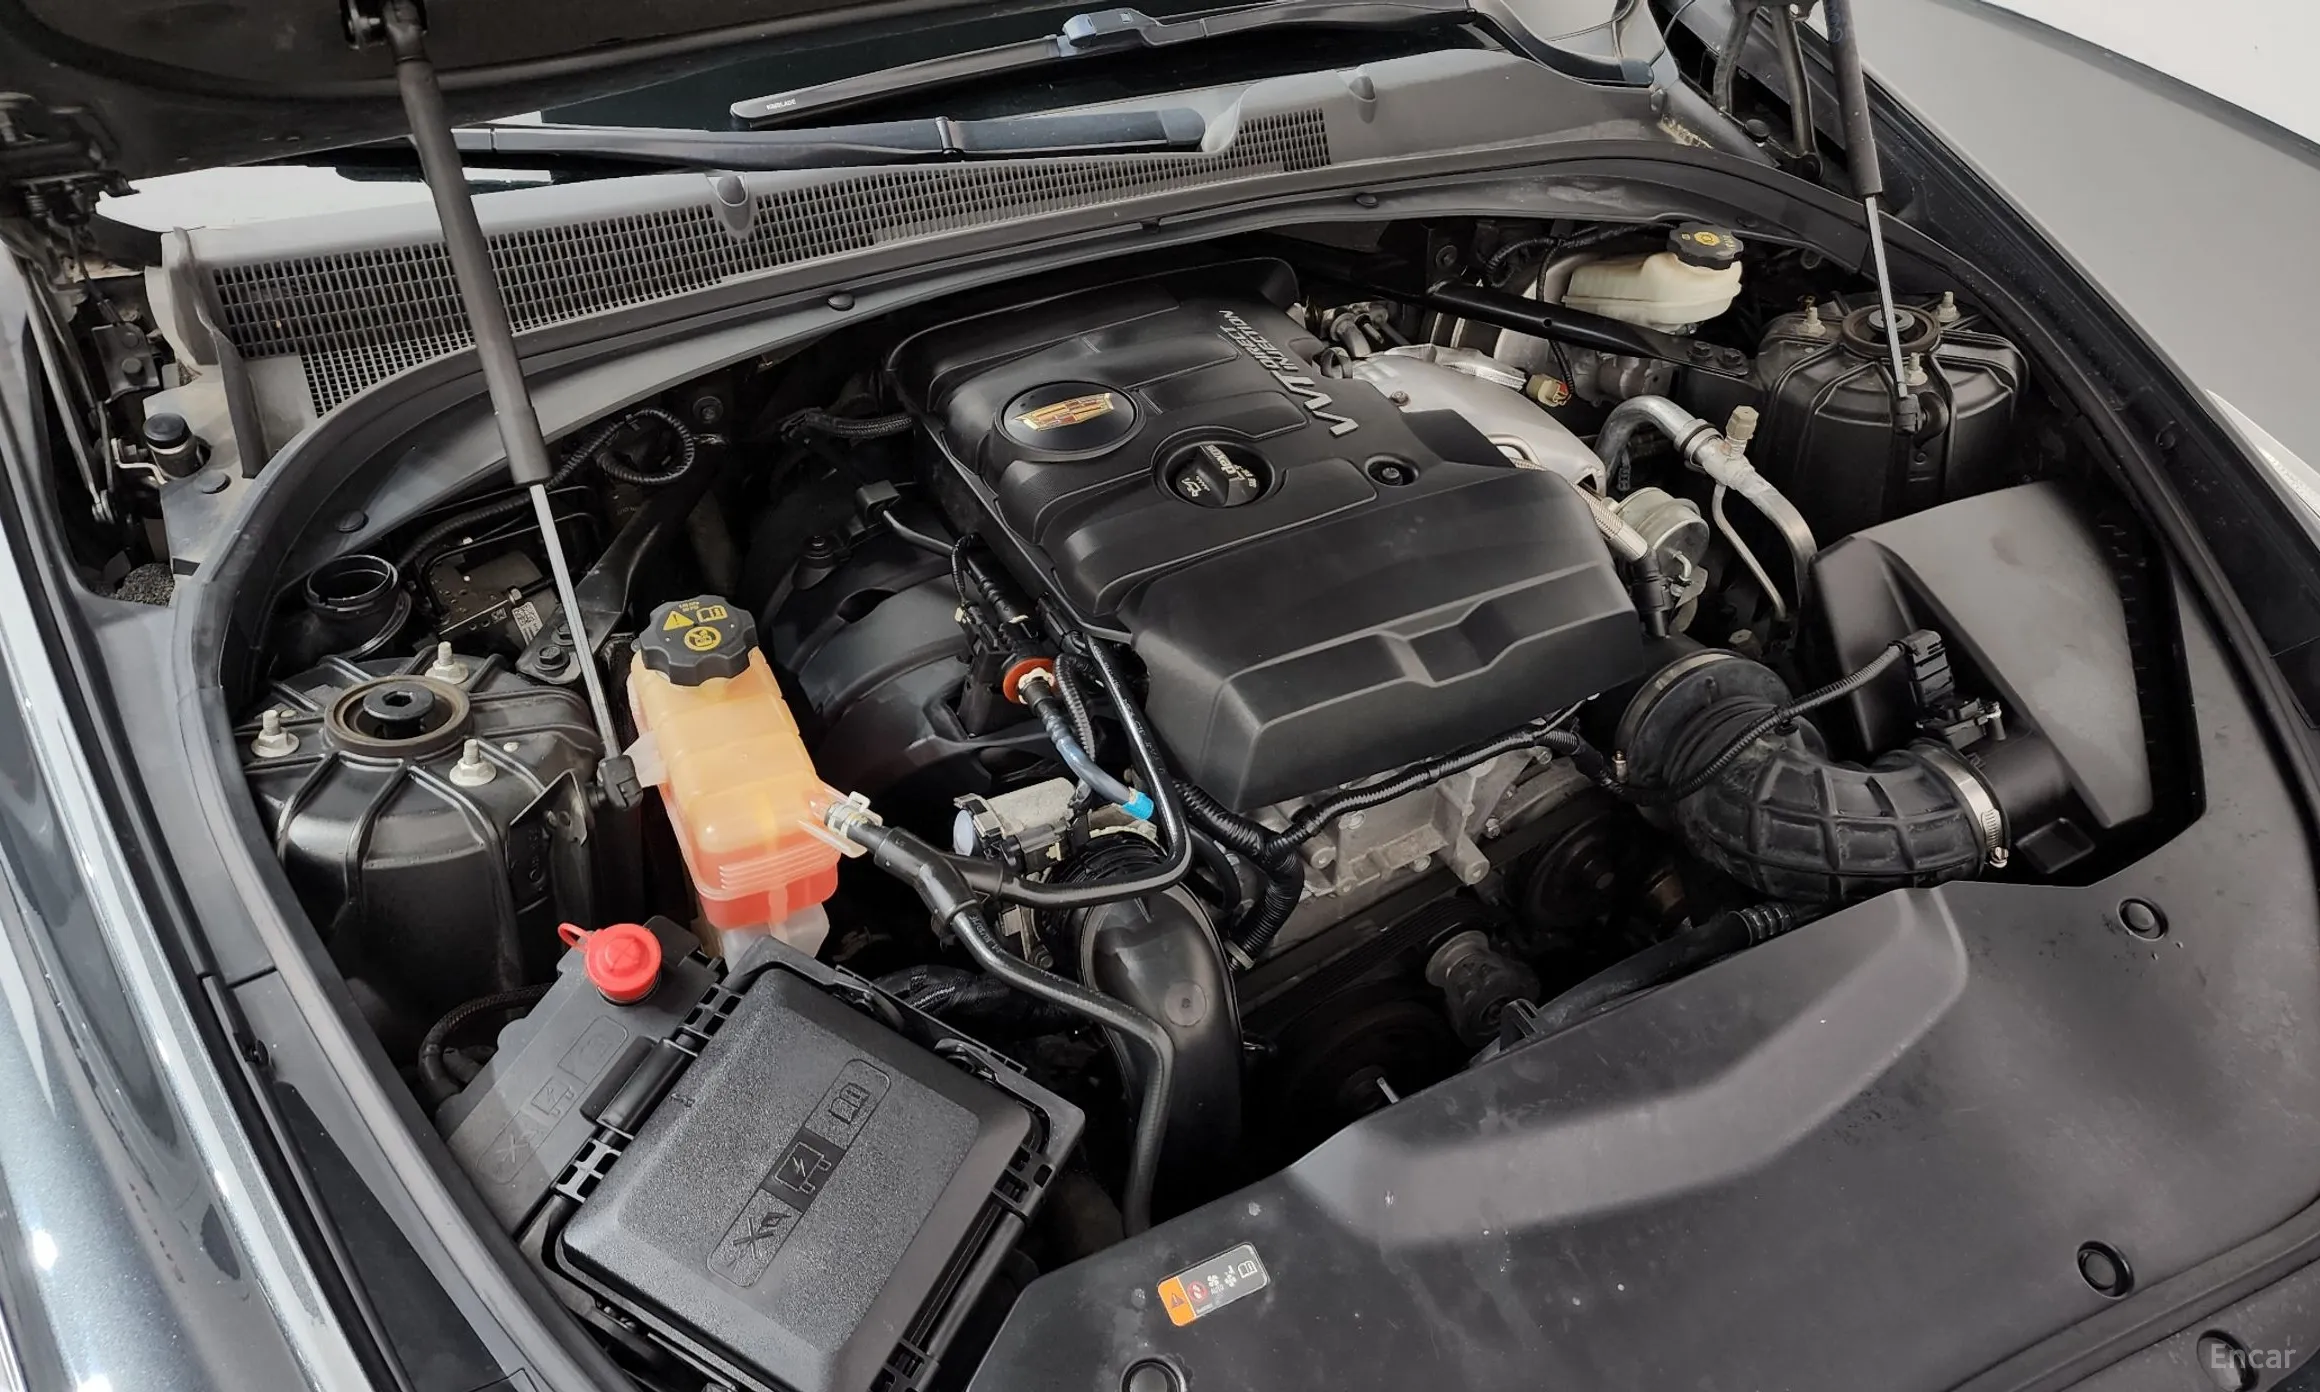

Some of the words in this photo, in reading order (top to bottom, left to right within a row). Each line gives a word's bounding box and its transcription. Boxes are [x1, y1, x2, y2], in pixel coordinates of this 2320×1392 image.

[1219, 310, 1299, 371] INJECTION
[1219, 325, 1280, 370] DIRECT
[1270, 370, 1359, 436] VVT
